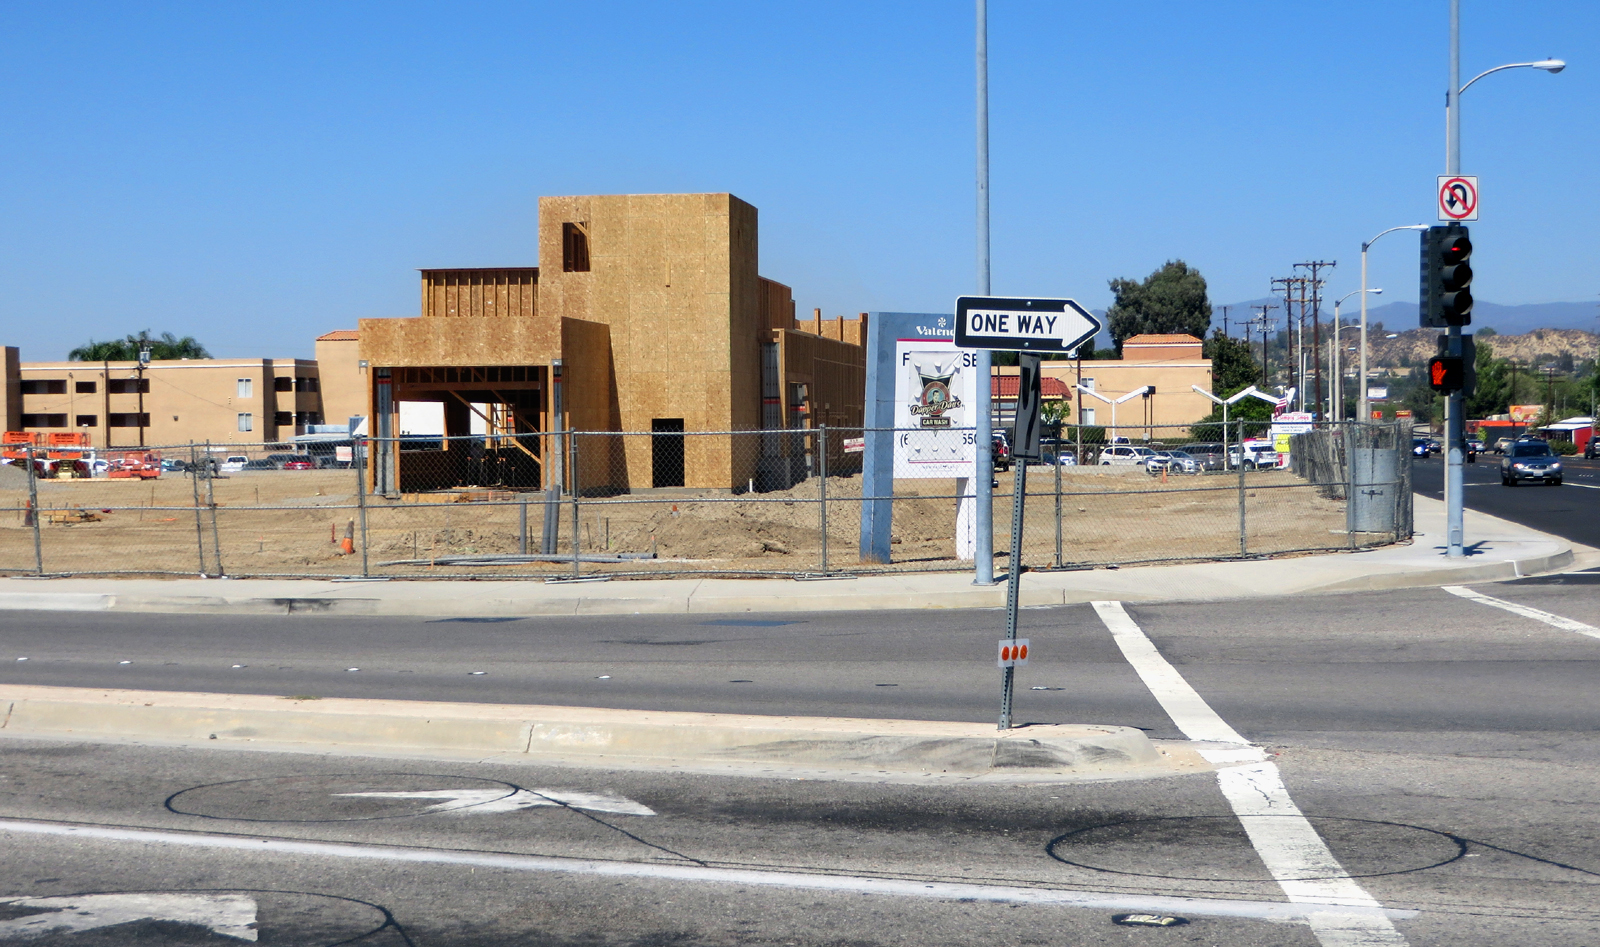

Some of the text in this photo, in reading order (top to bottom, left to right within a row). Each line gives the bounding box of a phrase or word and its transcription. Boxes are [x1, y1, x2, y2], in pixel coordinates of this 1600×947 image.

[915, 325, 954, 336] Valenc
[971, 313, 1058, 335] ONE WAY
